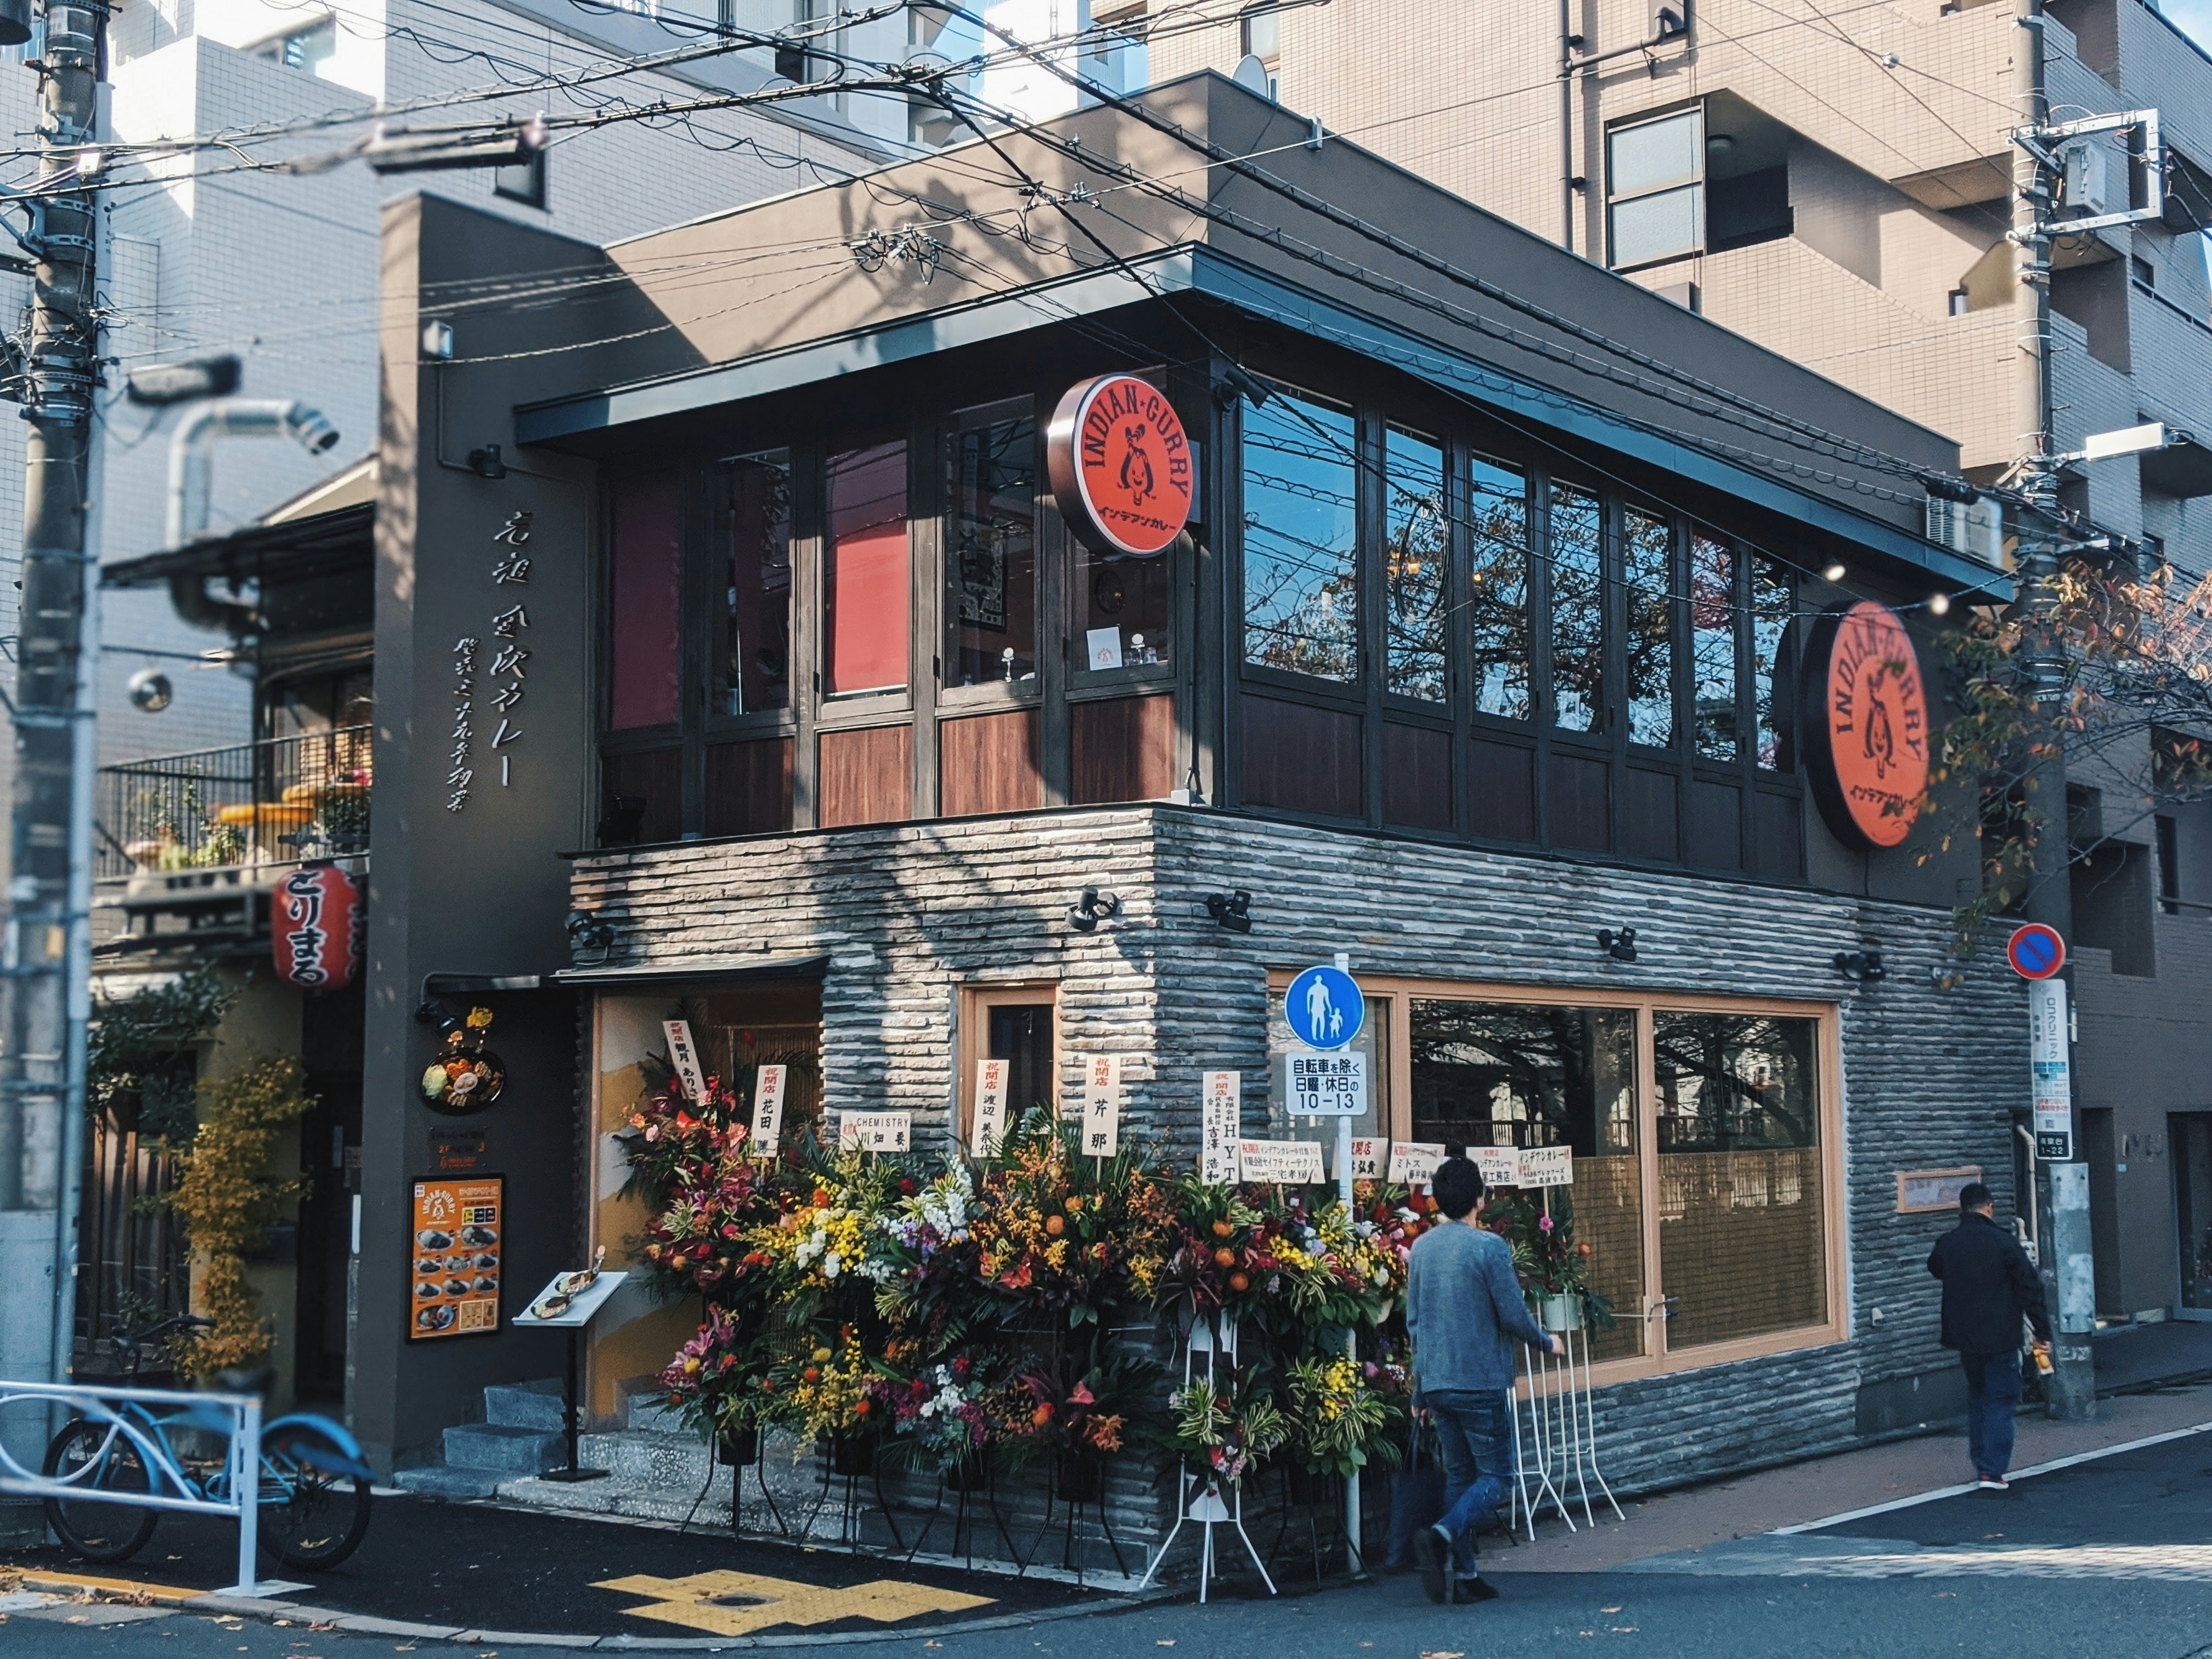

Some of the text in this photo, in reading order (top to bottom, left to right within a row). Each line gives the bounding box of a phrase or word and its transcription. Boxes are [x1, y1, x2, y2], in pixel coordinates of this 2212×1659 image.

[1085, 385, 1189, 498] INDIAN CURRY
[1836, 618, 1878, 735] INDIAN
[2047, 997, 2058, 1059] ロコクリニック
[763, 1067, 779, 1093] 祝開店
[984, 1062, 1000, 1090] 祝開店
[1293, 1059, 1360, 1074] 自転車を除く
[1092, 1057, 1111, 1150] 祝開店 芹那
[1300, 1093, 1354, 1109] 10-13
[857, 1118, 909, 1127] CHEMISTRY
